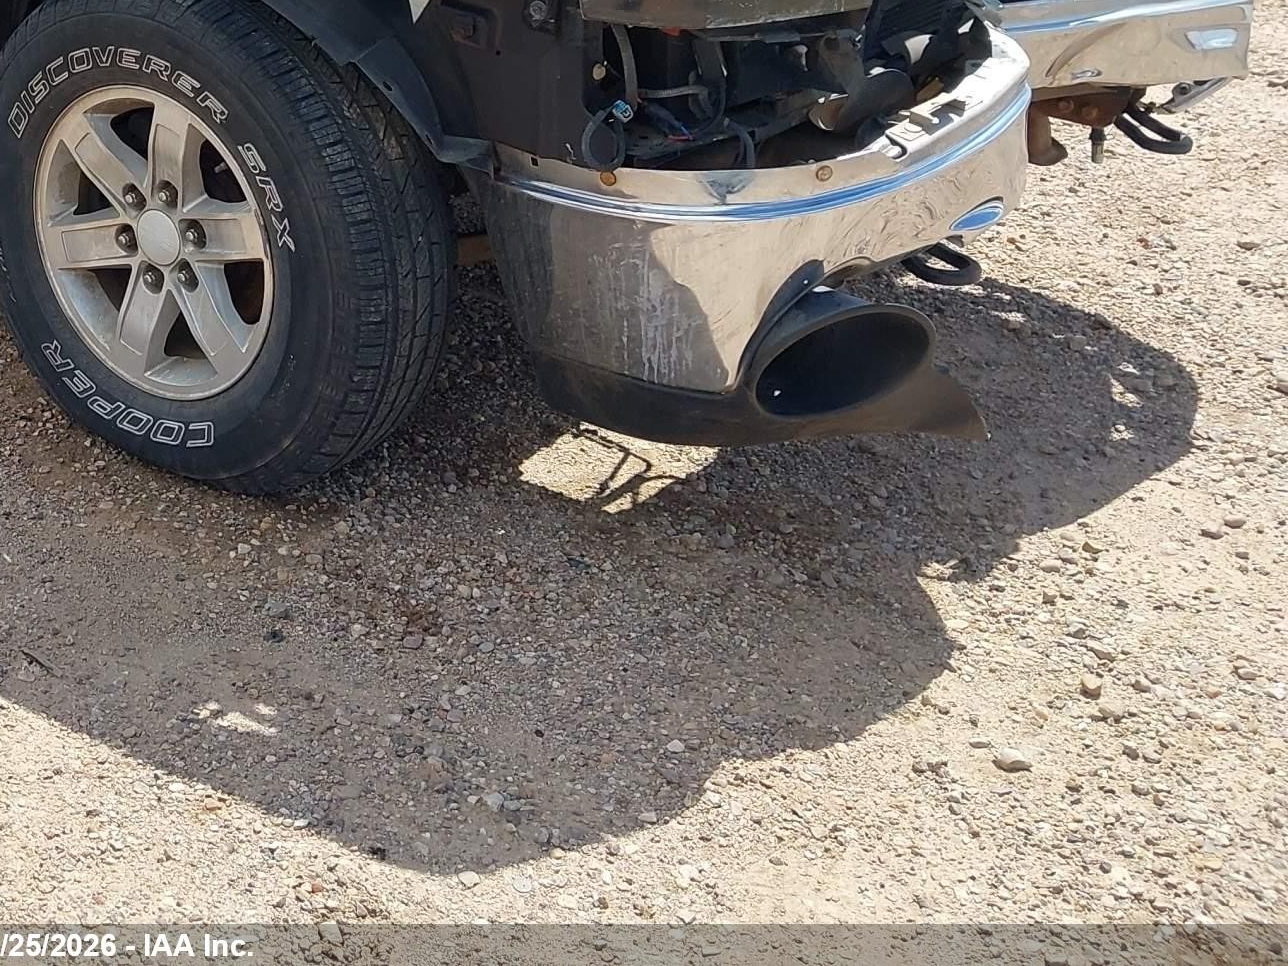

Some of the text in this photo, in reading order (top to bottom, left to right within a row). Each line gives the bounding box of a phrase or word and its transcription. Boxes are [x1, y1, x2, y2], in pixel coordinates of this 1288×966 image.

[7, 45, 296, 253] DISCOVERER SRX
[41, 338, 215, 449] COOPER
